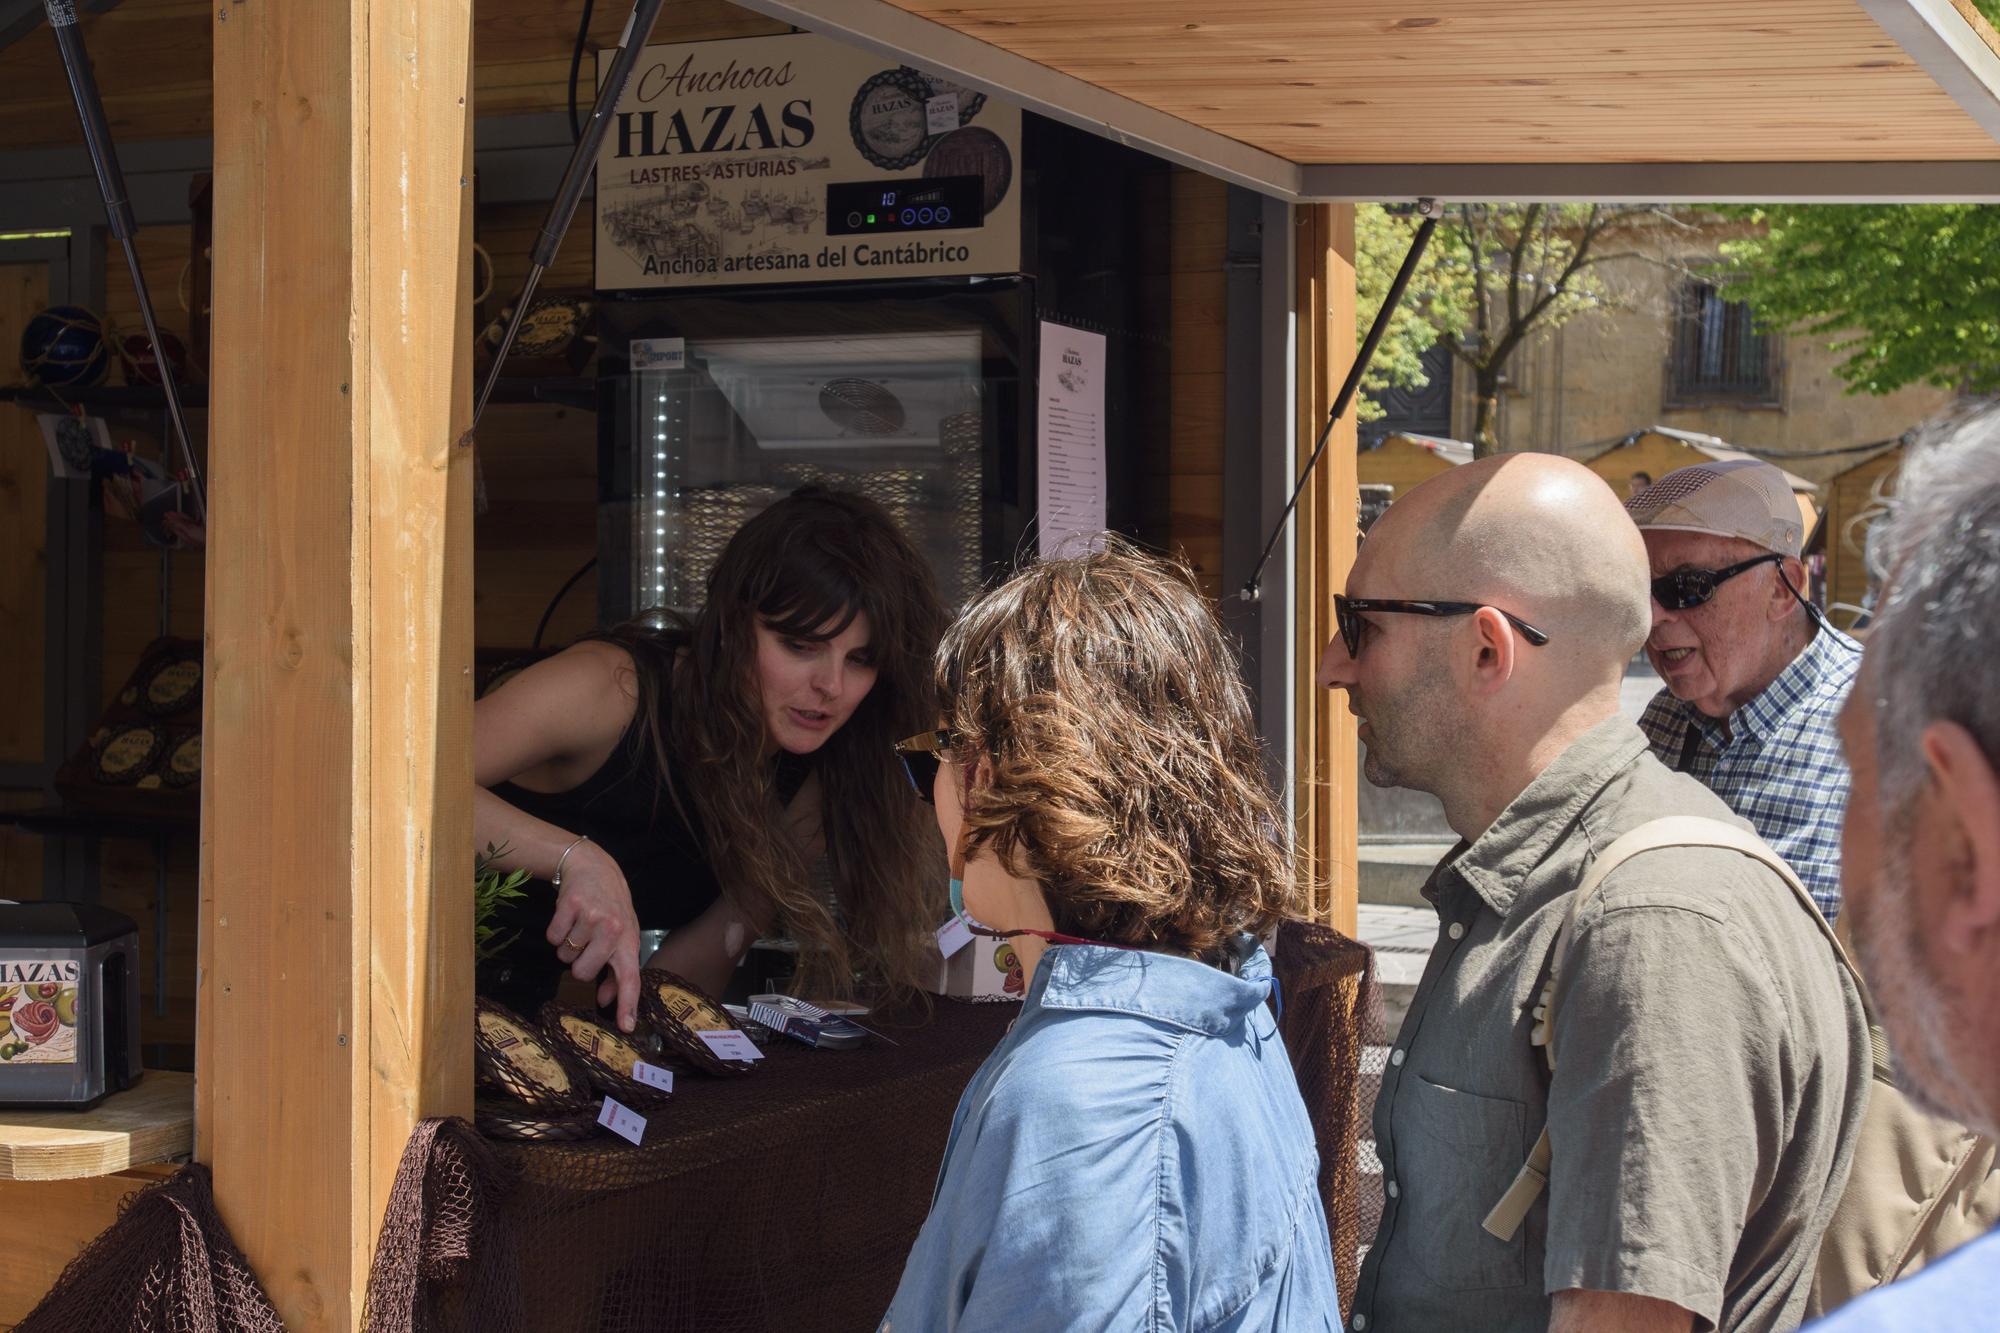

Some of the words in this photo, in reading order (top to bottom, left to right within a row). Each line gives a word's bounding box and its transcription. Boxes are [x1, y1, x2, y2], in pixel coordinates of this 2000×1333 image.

[638, 53, 797, 103] Anchoas
[614, 98, 815, 158] HAZAS
[643, 253, 718, 275] Anchoa
[723, 248, 811, 271] artesana
[816, 245, 847, 267] del
[852, 239, 970, 265] Cantábrico
